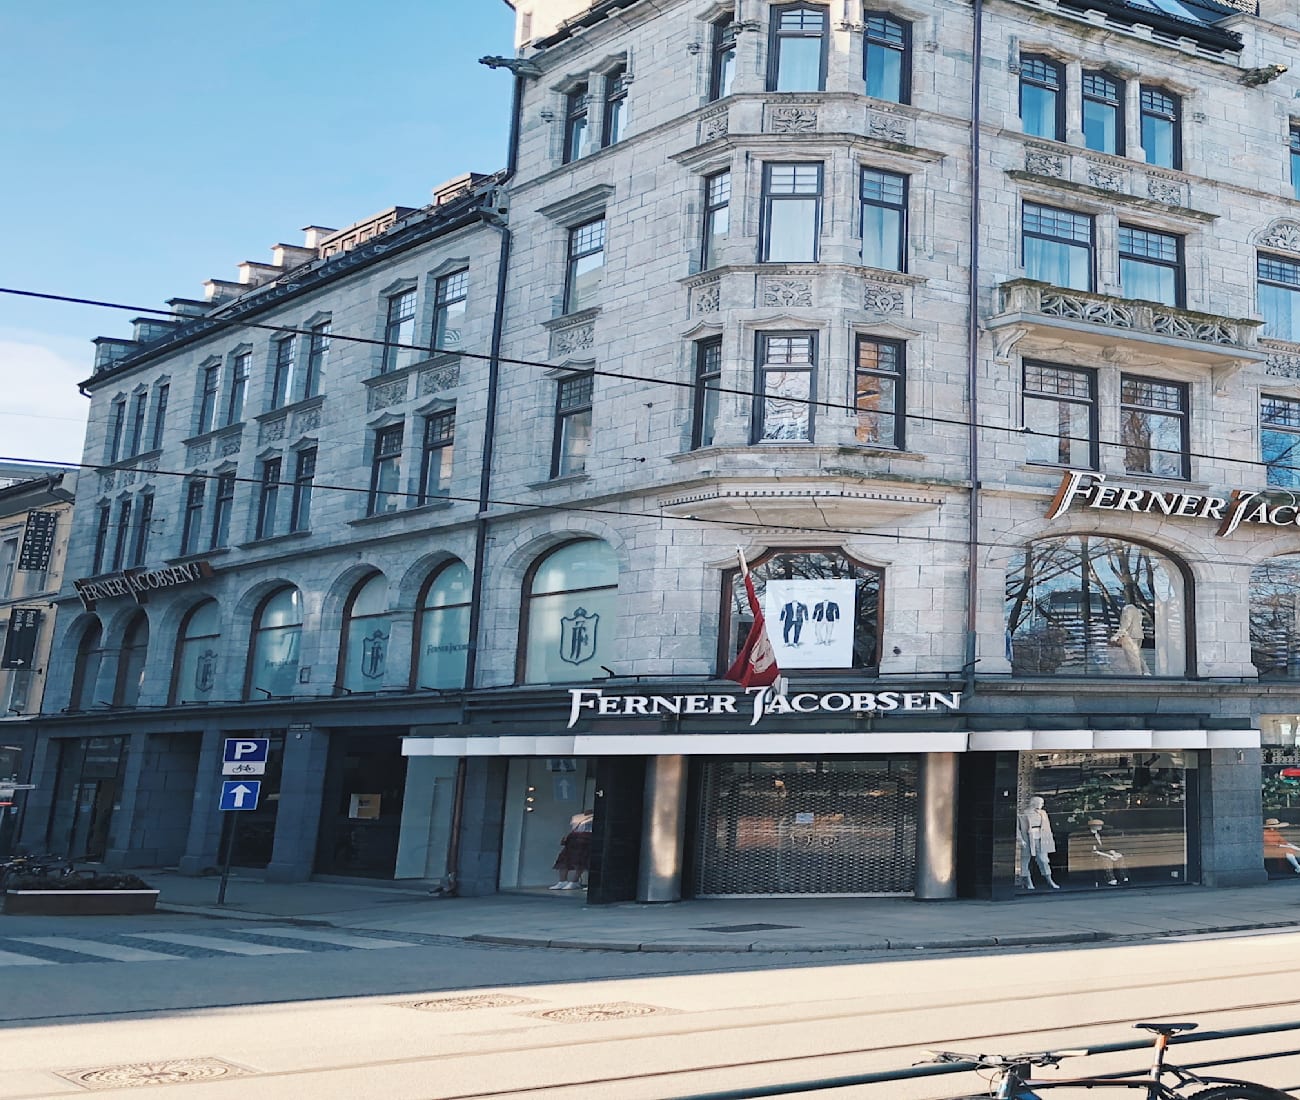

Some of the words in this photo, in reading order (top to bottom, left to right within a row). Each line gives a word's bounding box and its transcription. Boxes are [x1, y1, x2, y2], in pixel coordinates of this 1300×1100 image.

[1047, 471, 1226, 520] FERNER
[72, 579, 128, 610] FERNER
[121, 562, 194, 605] JACOBSEN
[567, 689, 738, 729] FERNER
[744, 686, 963, 726] JACOBSEN
[234, 742, 258, 760] P
